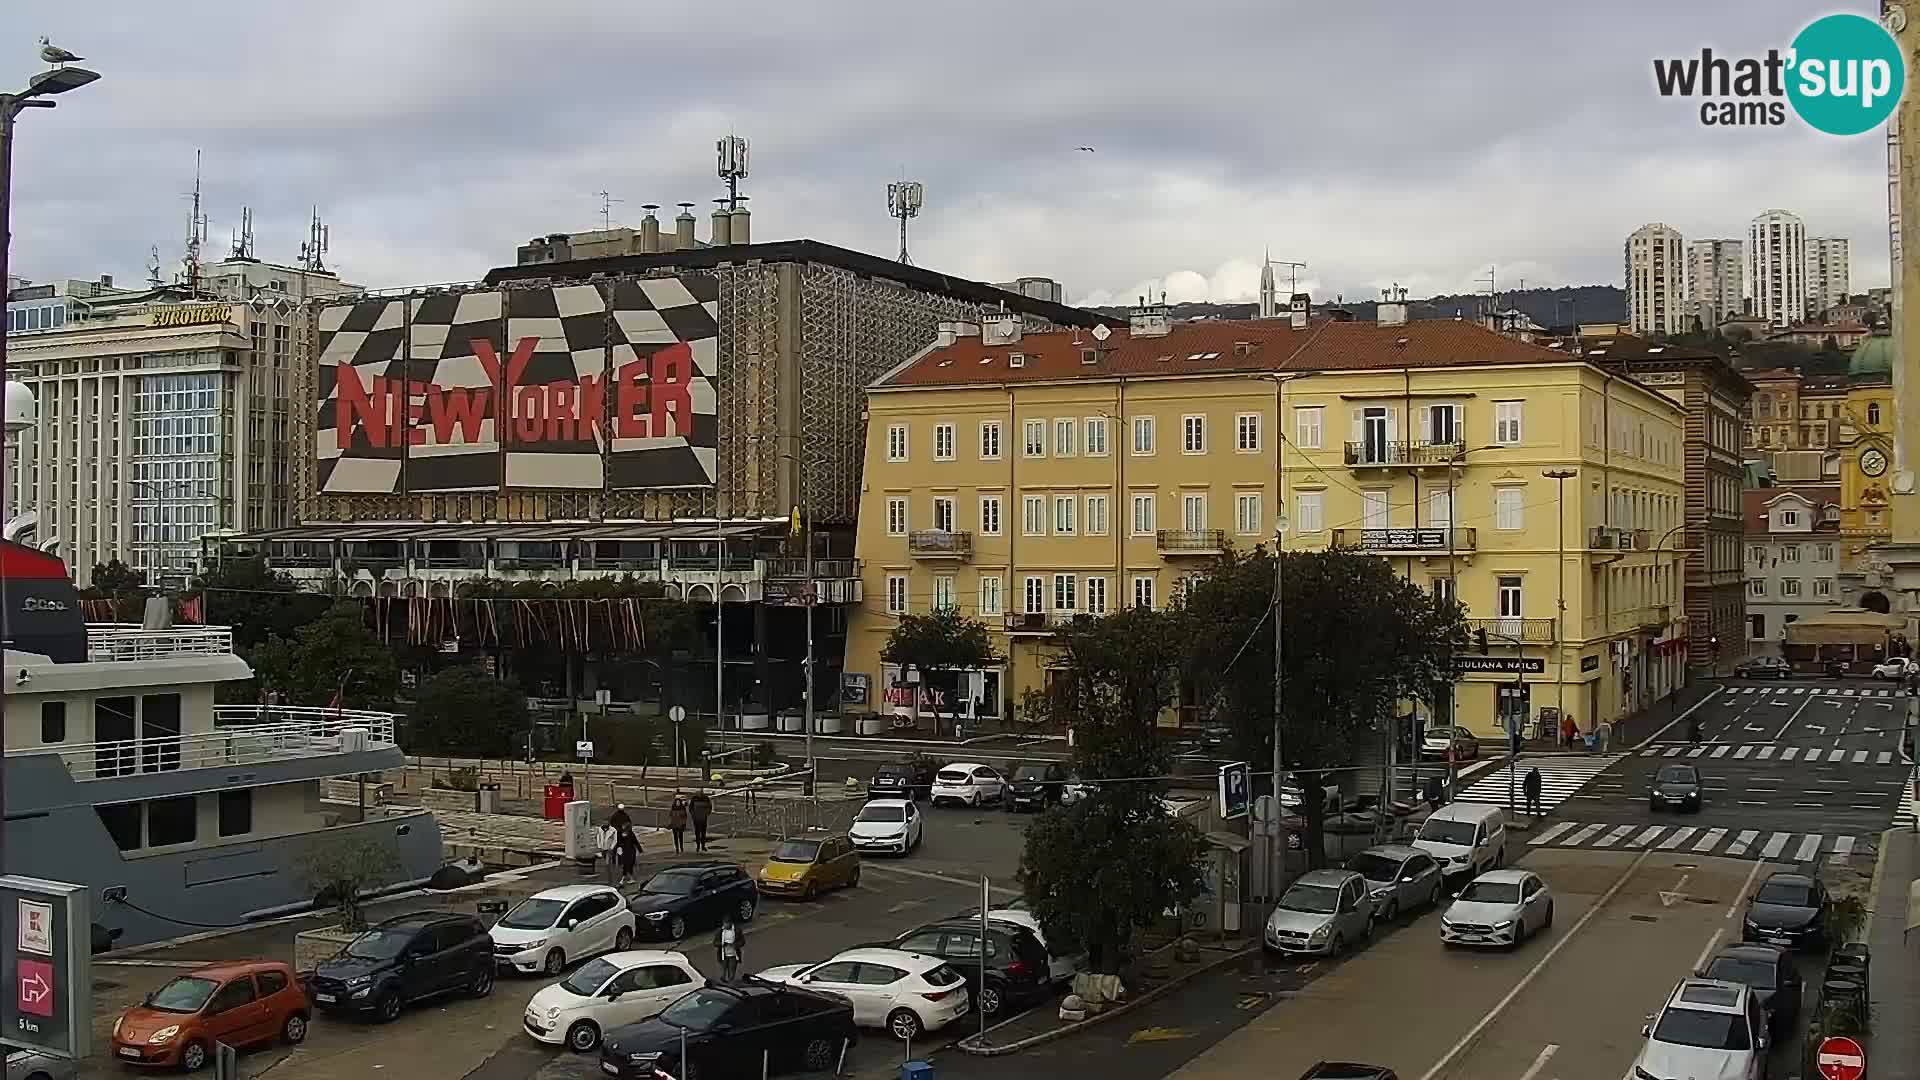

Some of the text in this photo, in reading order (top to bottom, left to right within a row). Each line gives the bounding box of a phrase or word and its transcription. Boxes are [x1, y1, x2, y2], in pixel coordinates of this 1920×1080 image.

[1458, 661, 1539, 671] JULIANA NAILS
[1230, 770, 1242, 794] P
[19, 1018, 39, 1033] 5 km
